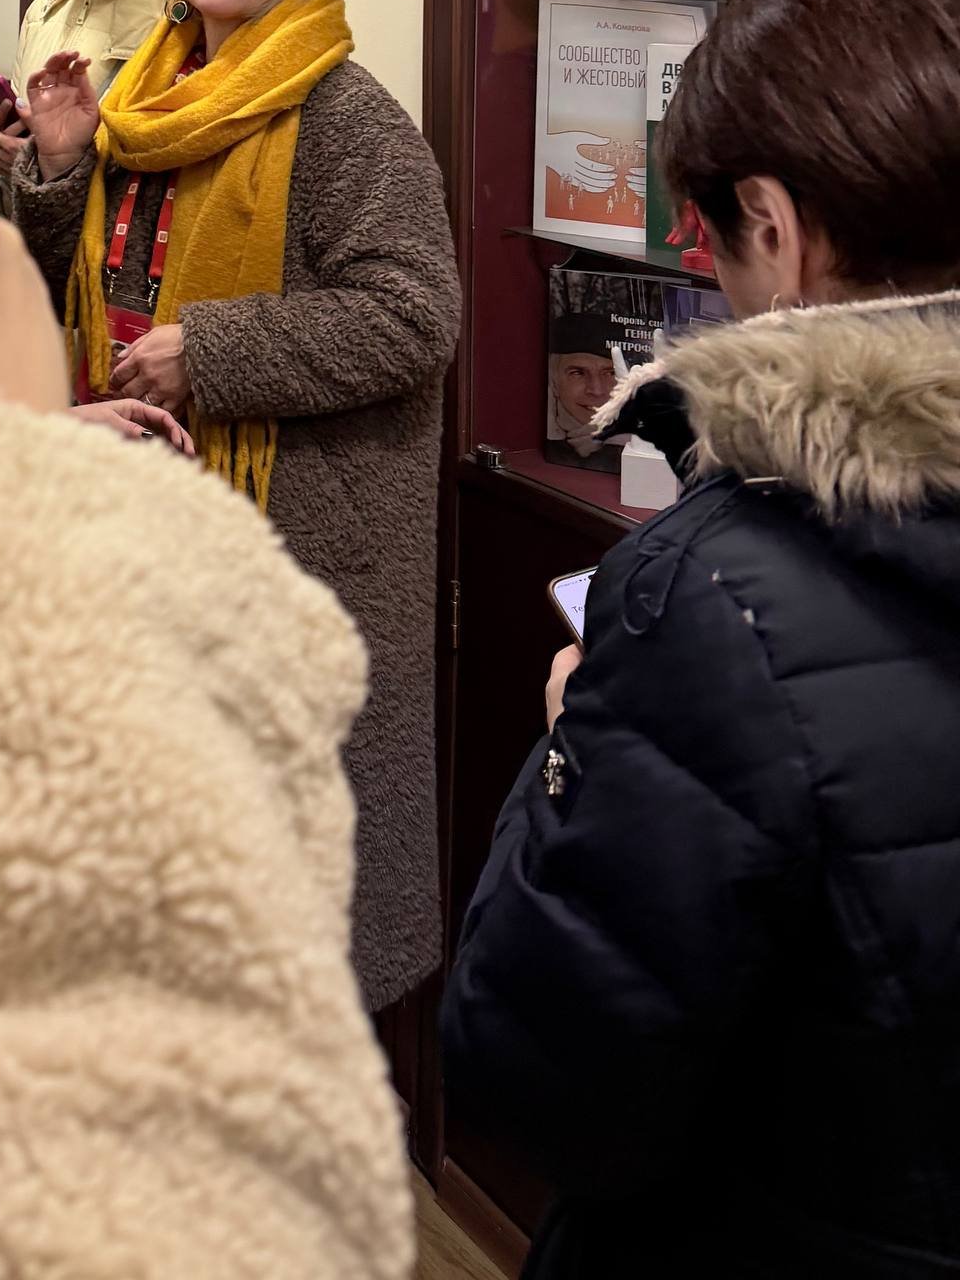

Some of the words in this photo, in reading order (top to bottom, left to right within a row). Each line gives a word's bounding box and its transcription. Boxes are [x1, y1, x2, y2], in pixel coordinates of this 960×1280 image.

[612, 22, 651, 33] Комарова
[558, 45, 641, 66] СООБЩЕСТВО
[564, 68, 572, 83] И
[576, 68, 647, 89] ЖЕСТОВЫЙ
[611, 313, 646, 326] Король
